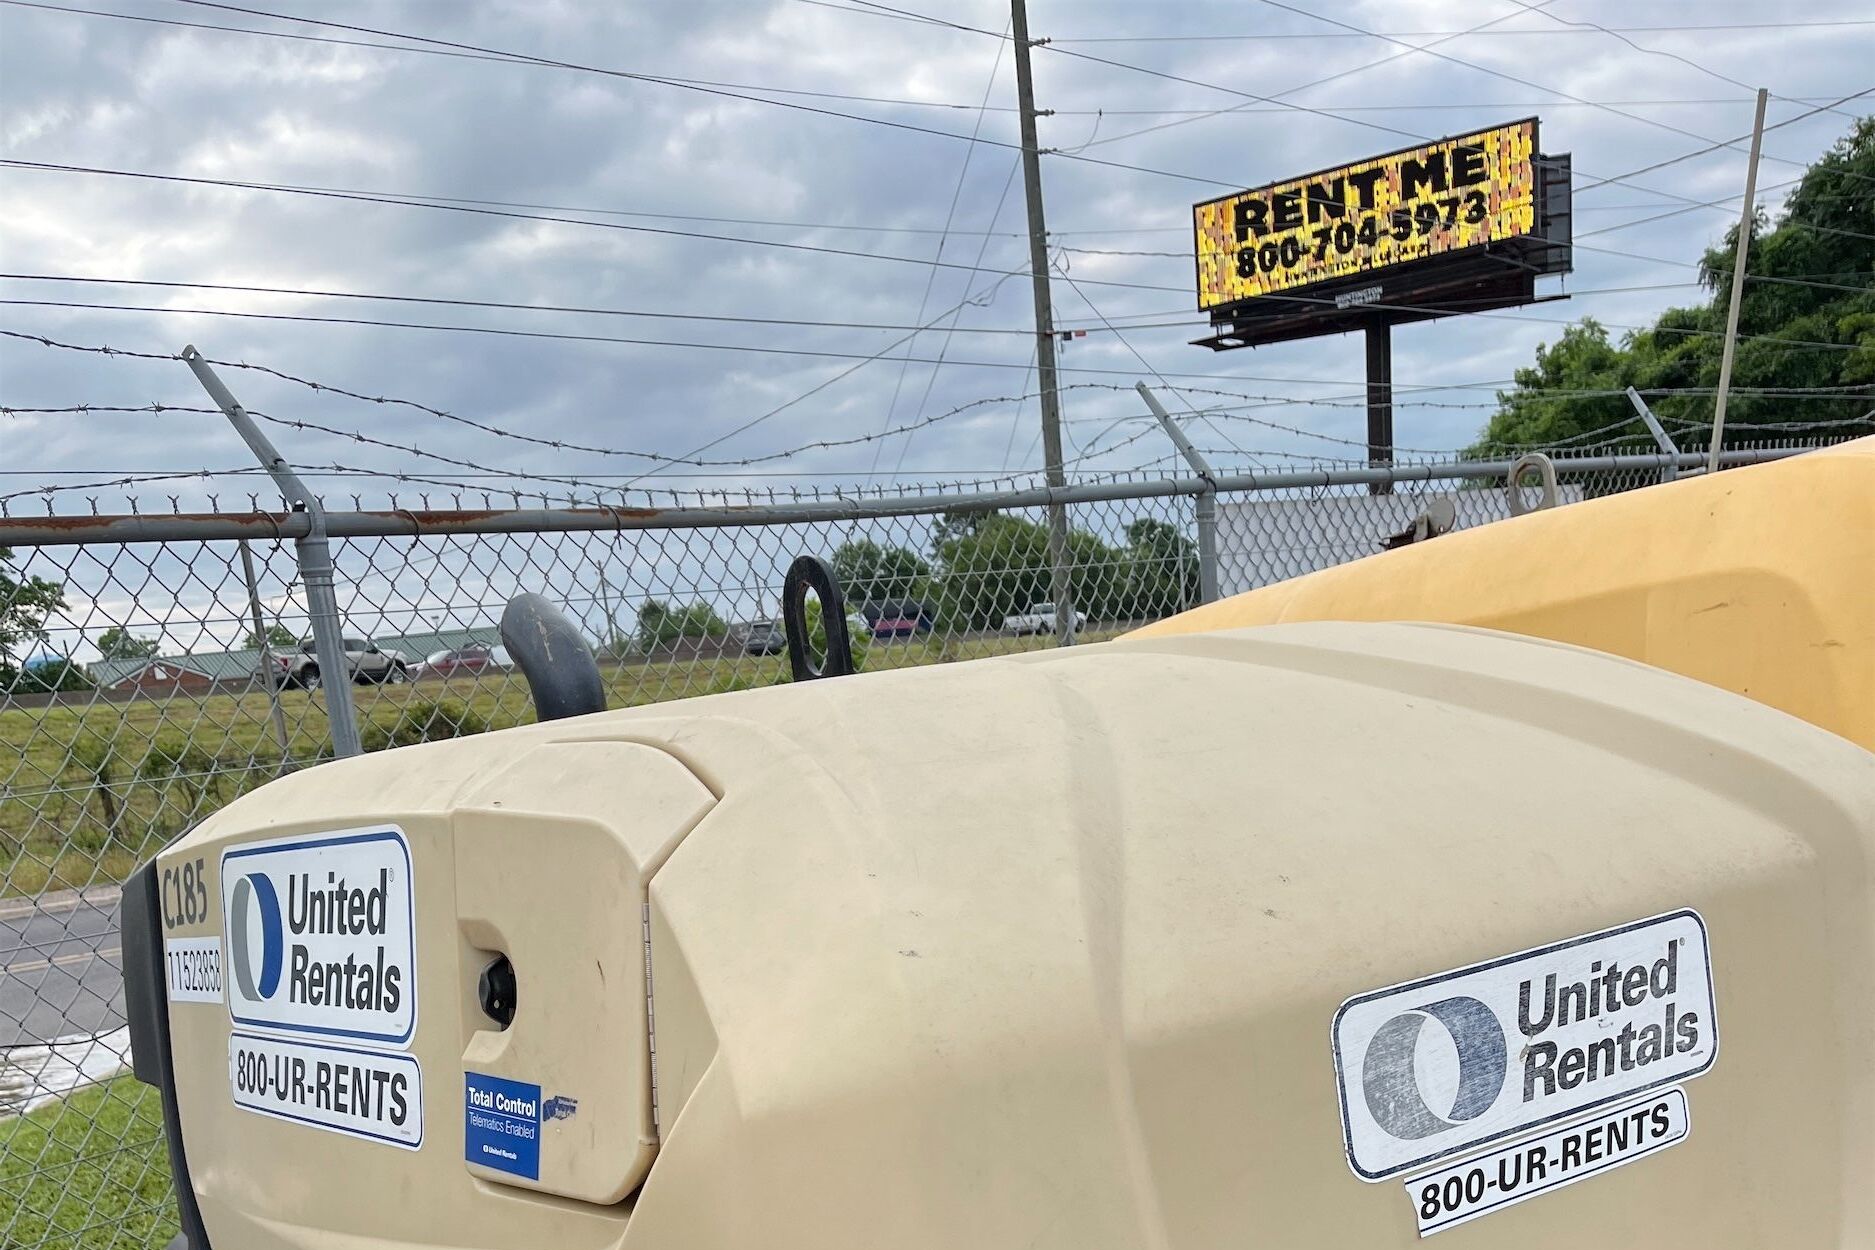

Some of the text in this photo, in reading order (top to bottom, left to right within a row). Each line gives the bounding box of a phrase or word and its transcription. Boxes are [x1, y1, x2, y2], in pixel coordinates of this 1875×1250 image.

[1235, 141, 1488, 242] RENT ME
[1237, 191, 1487, 278] 800-704-5973
[163, 858, 207, 930] C185
[288, 868, 388, 936] United
[168, 949, 221, 992] 11523858
[289, 944, 401, 1014] Rentals
[1517, 938, 1678, 1037] United
[237, 1049, 408, 1127] 800-UR-RENTS
[1522, 1003, 1699, 1104] Rentals
[468, 1087, 536, 1117] Total Control
[469, 1112, 535, 1139] Telematics Enabled
[1420, 1102, 1670, 1220] 800-UR-RENTS
